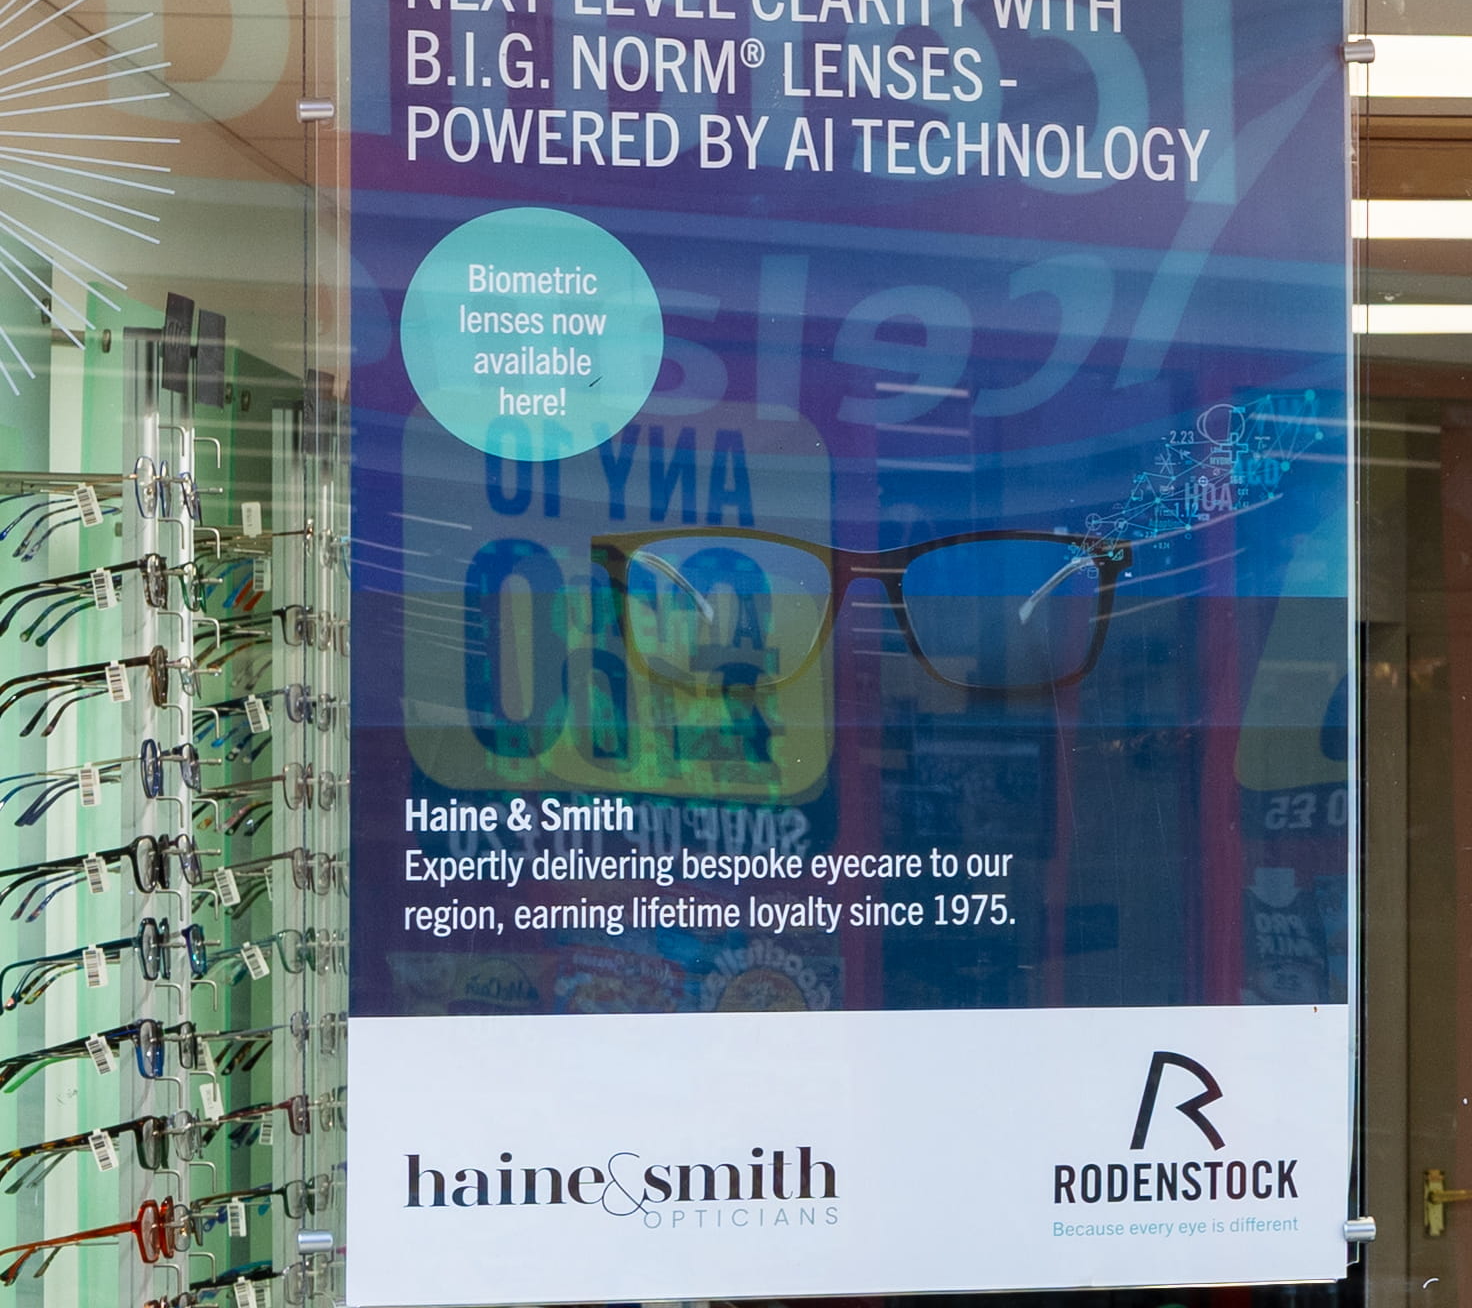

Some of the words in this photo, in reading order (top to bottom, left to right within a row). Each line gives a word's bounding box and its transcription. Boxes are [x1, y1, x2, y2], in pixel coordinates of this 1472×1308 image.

[407, 29, 550, 89] B.I.G.
[782, 41, 983, 102] LENSES
[407, 105, 680, 167] POWERED
[699, 113, 769, 170] BY
[784, 116, 834, 172] AI
[851, 118, 1211, 182] TECHNOLOGY
[468, 263, 598, 295] Biometric
[459, 304, 545, 335] lenses
[552, 313, 607, 336] now
[473, 345, 592, 376] available
[499, 386, 566, 416] here!
[405, 798, 498, 832] Haine
[506, 797, 533, 832] &
[540, 797, 634, 832] Smith
[405, 848, 525, 888] Expertly
[532, 848, 675, 887] delivering
[682, 847, 803, 886] bespoke
[811, 854, 922, 886] eyecare
[929, 847, 959, 878] to
[966, 853, 1014, 878] our
[404, 898, 504, 938] region,
[514, 897, 625, 936] earning
[632, 896, 741, 928] lifetime
[749, 895, 843, 934] loyalty
[849, 895, 924, 927] since
[934, 893, 1016, 926] 1975.
[403, 1146, 839, 1217] haine&smith
[1054, 1159, 1299, 1204] RODENSTOCK
[643, 1206, 840, 1230] OPTICIANS
[1053, 1221, 1125, 1237] Because
[1129, 1222, 1174, 1238] every
[1178, 1221, 1207, 1237] eye
[1210, 1216, 1225, 1238] is
[1229, 1216, 1299, 1233] different
